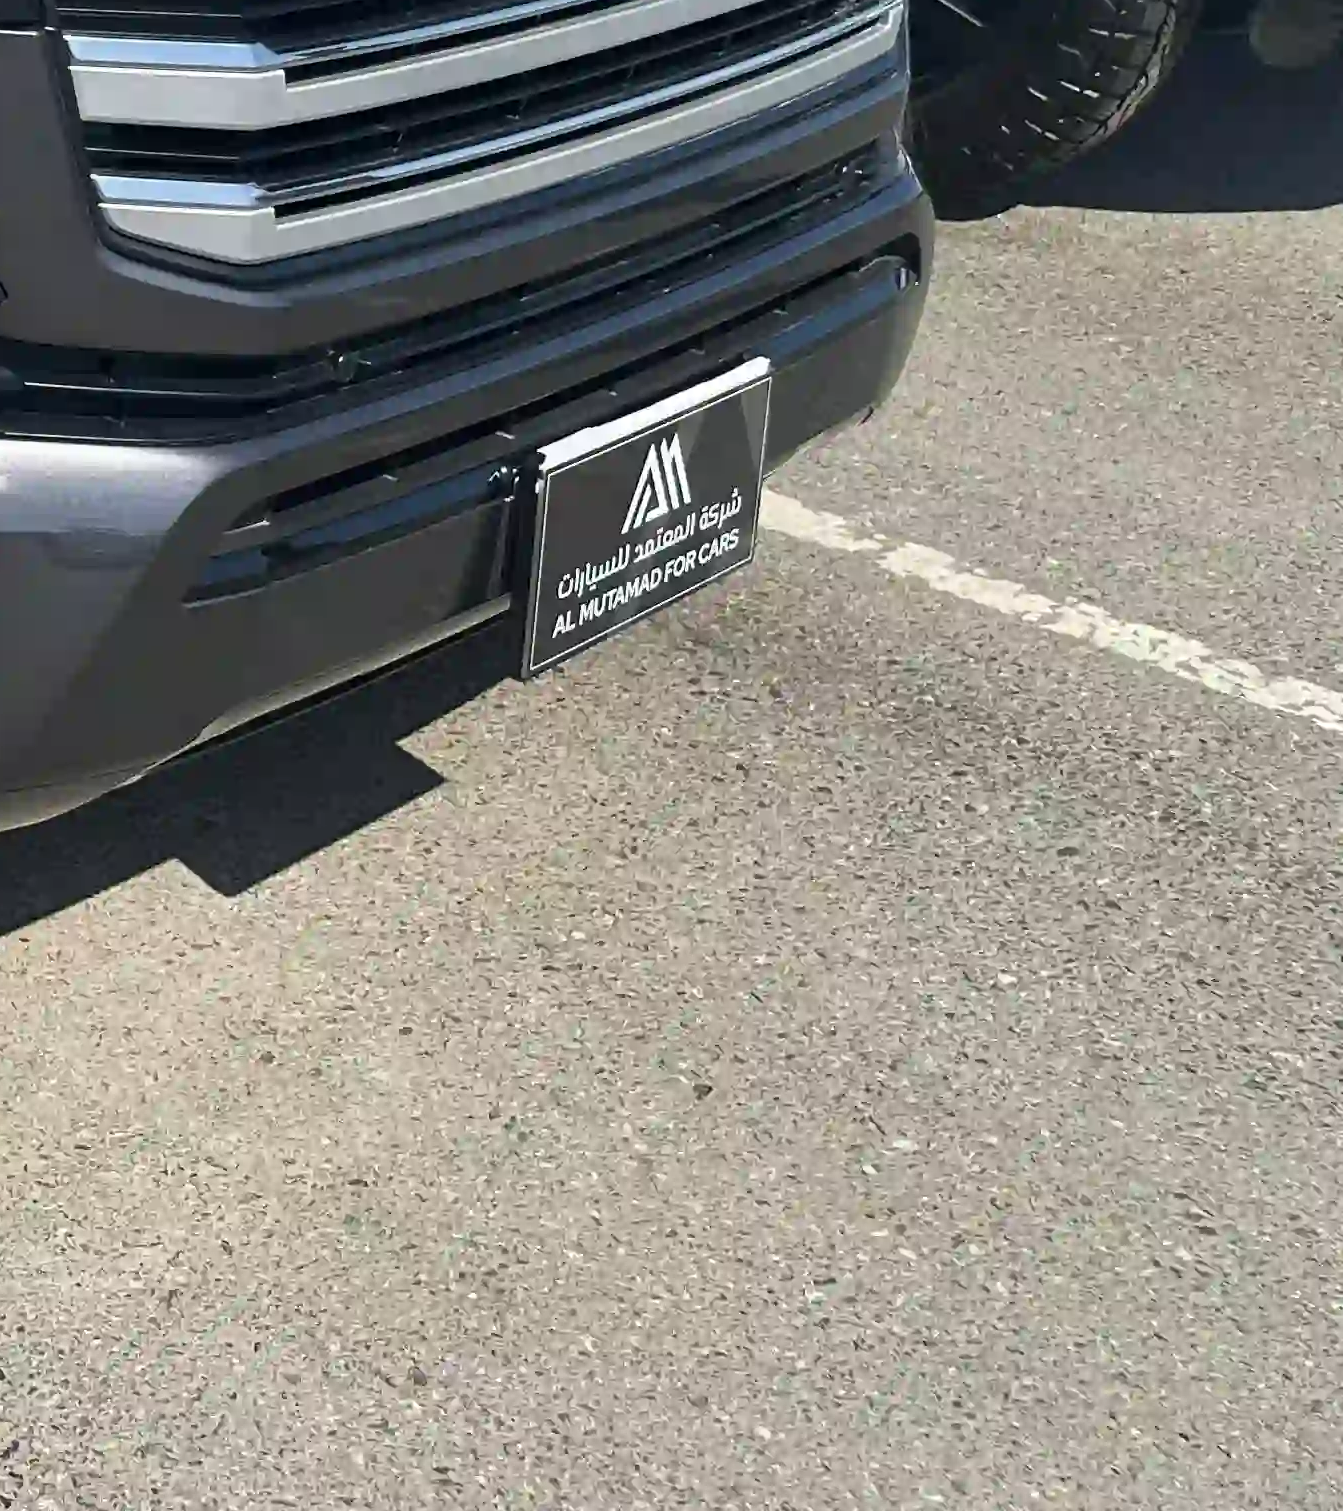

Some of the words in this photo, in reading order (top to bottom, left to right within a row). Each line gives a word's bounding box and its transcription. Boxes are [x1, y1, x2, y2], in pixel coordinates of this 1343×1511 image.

[699, 488, 743, 532] شركة
[551, 610, 576, 639] AL
[578, 567, 663, 625] MUTAMAD
[664, 552, 697, 584] FOR
[698, 528, 740, 570] CARS
